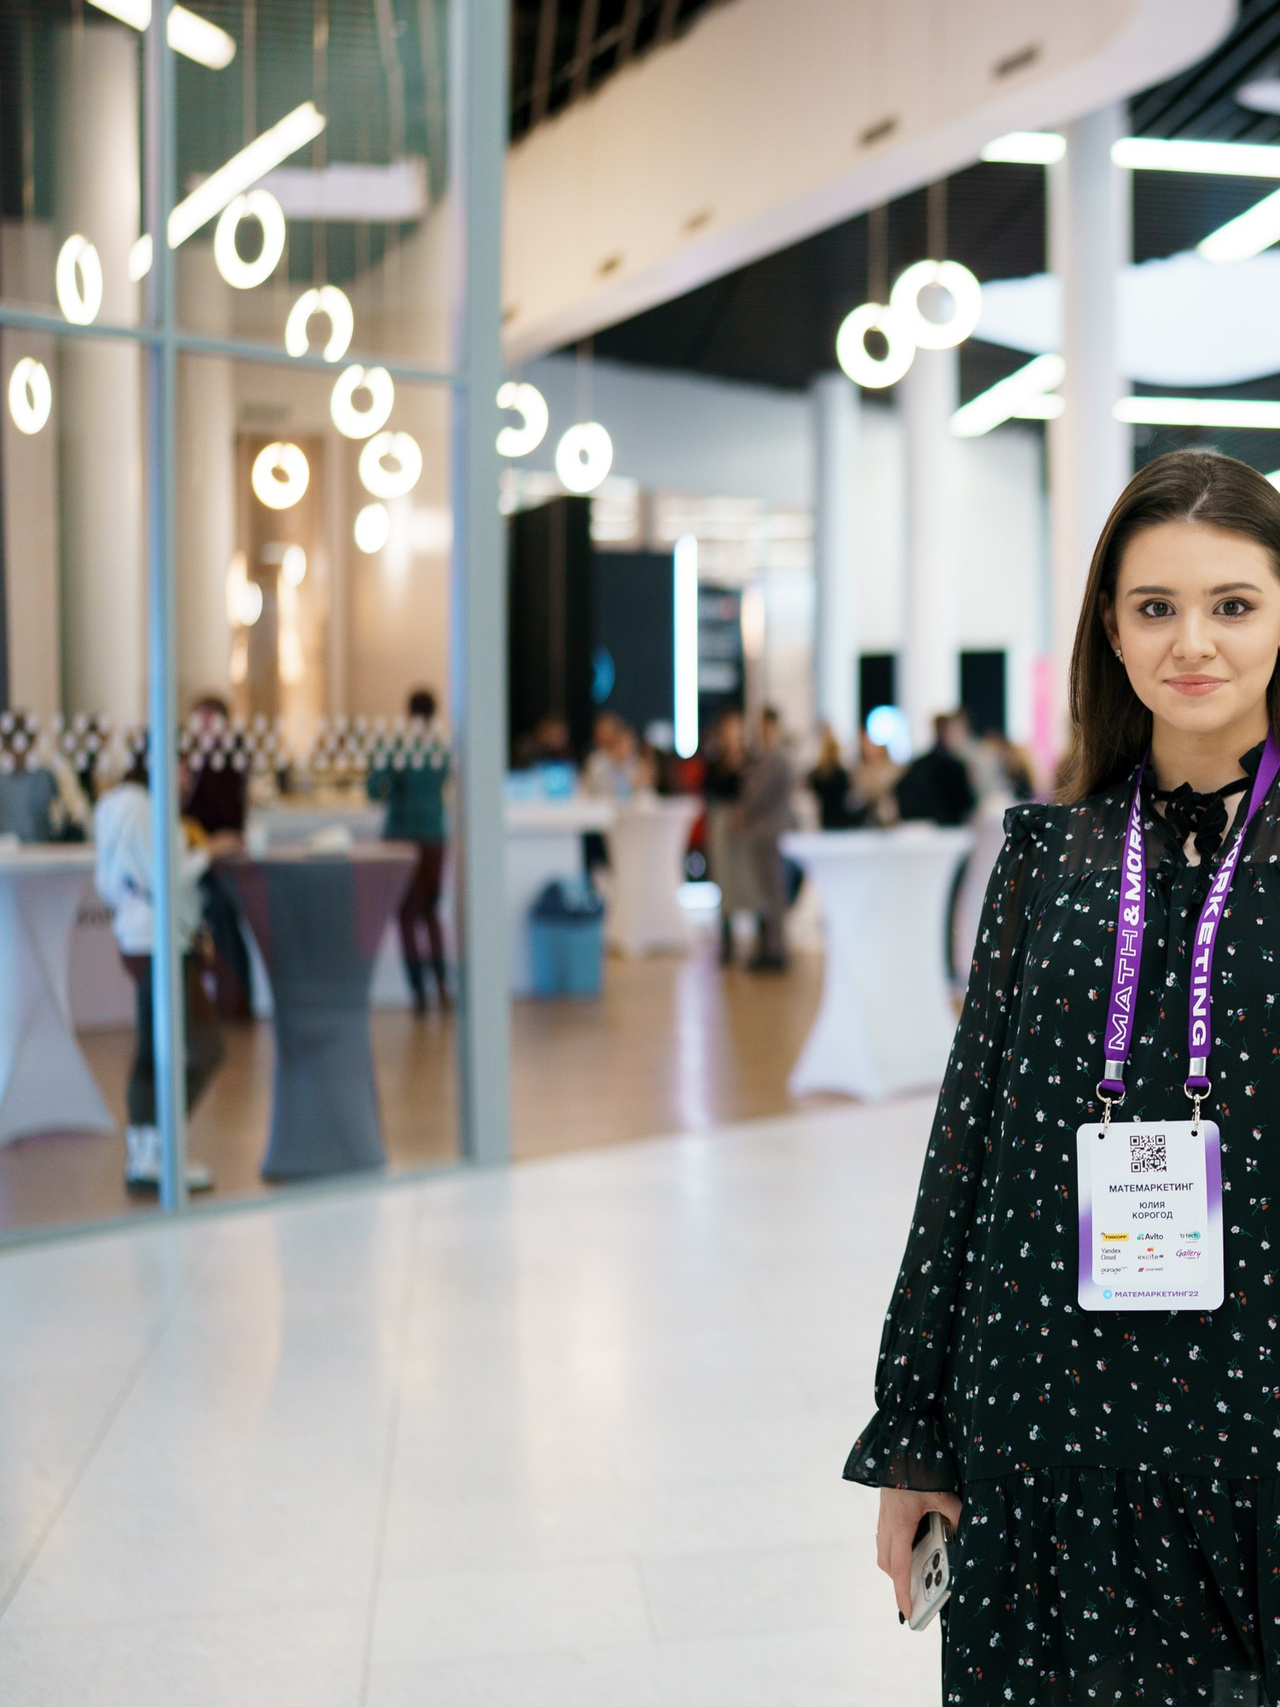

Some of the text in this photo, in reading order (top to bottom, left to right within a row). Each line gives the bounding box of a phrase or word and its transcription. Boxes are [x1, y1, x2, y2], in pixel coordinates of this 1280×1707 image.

[1108, 929, 1138, 1050] MATH
[1124, 904, 1140, 926] &
[1109, 1182, 1194, 1193] МАТЕМАРКЕТИНГ
[1139, 1201, 1165, 1209] ЮЛИЯ
[1132, 1211, 1173, 1220] КОРОГОД
[1176, 1249, 1201, 1259] Gallery
